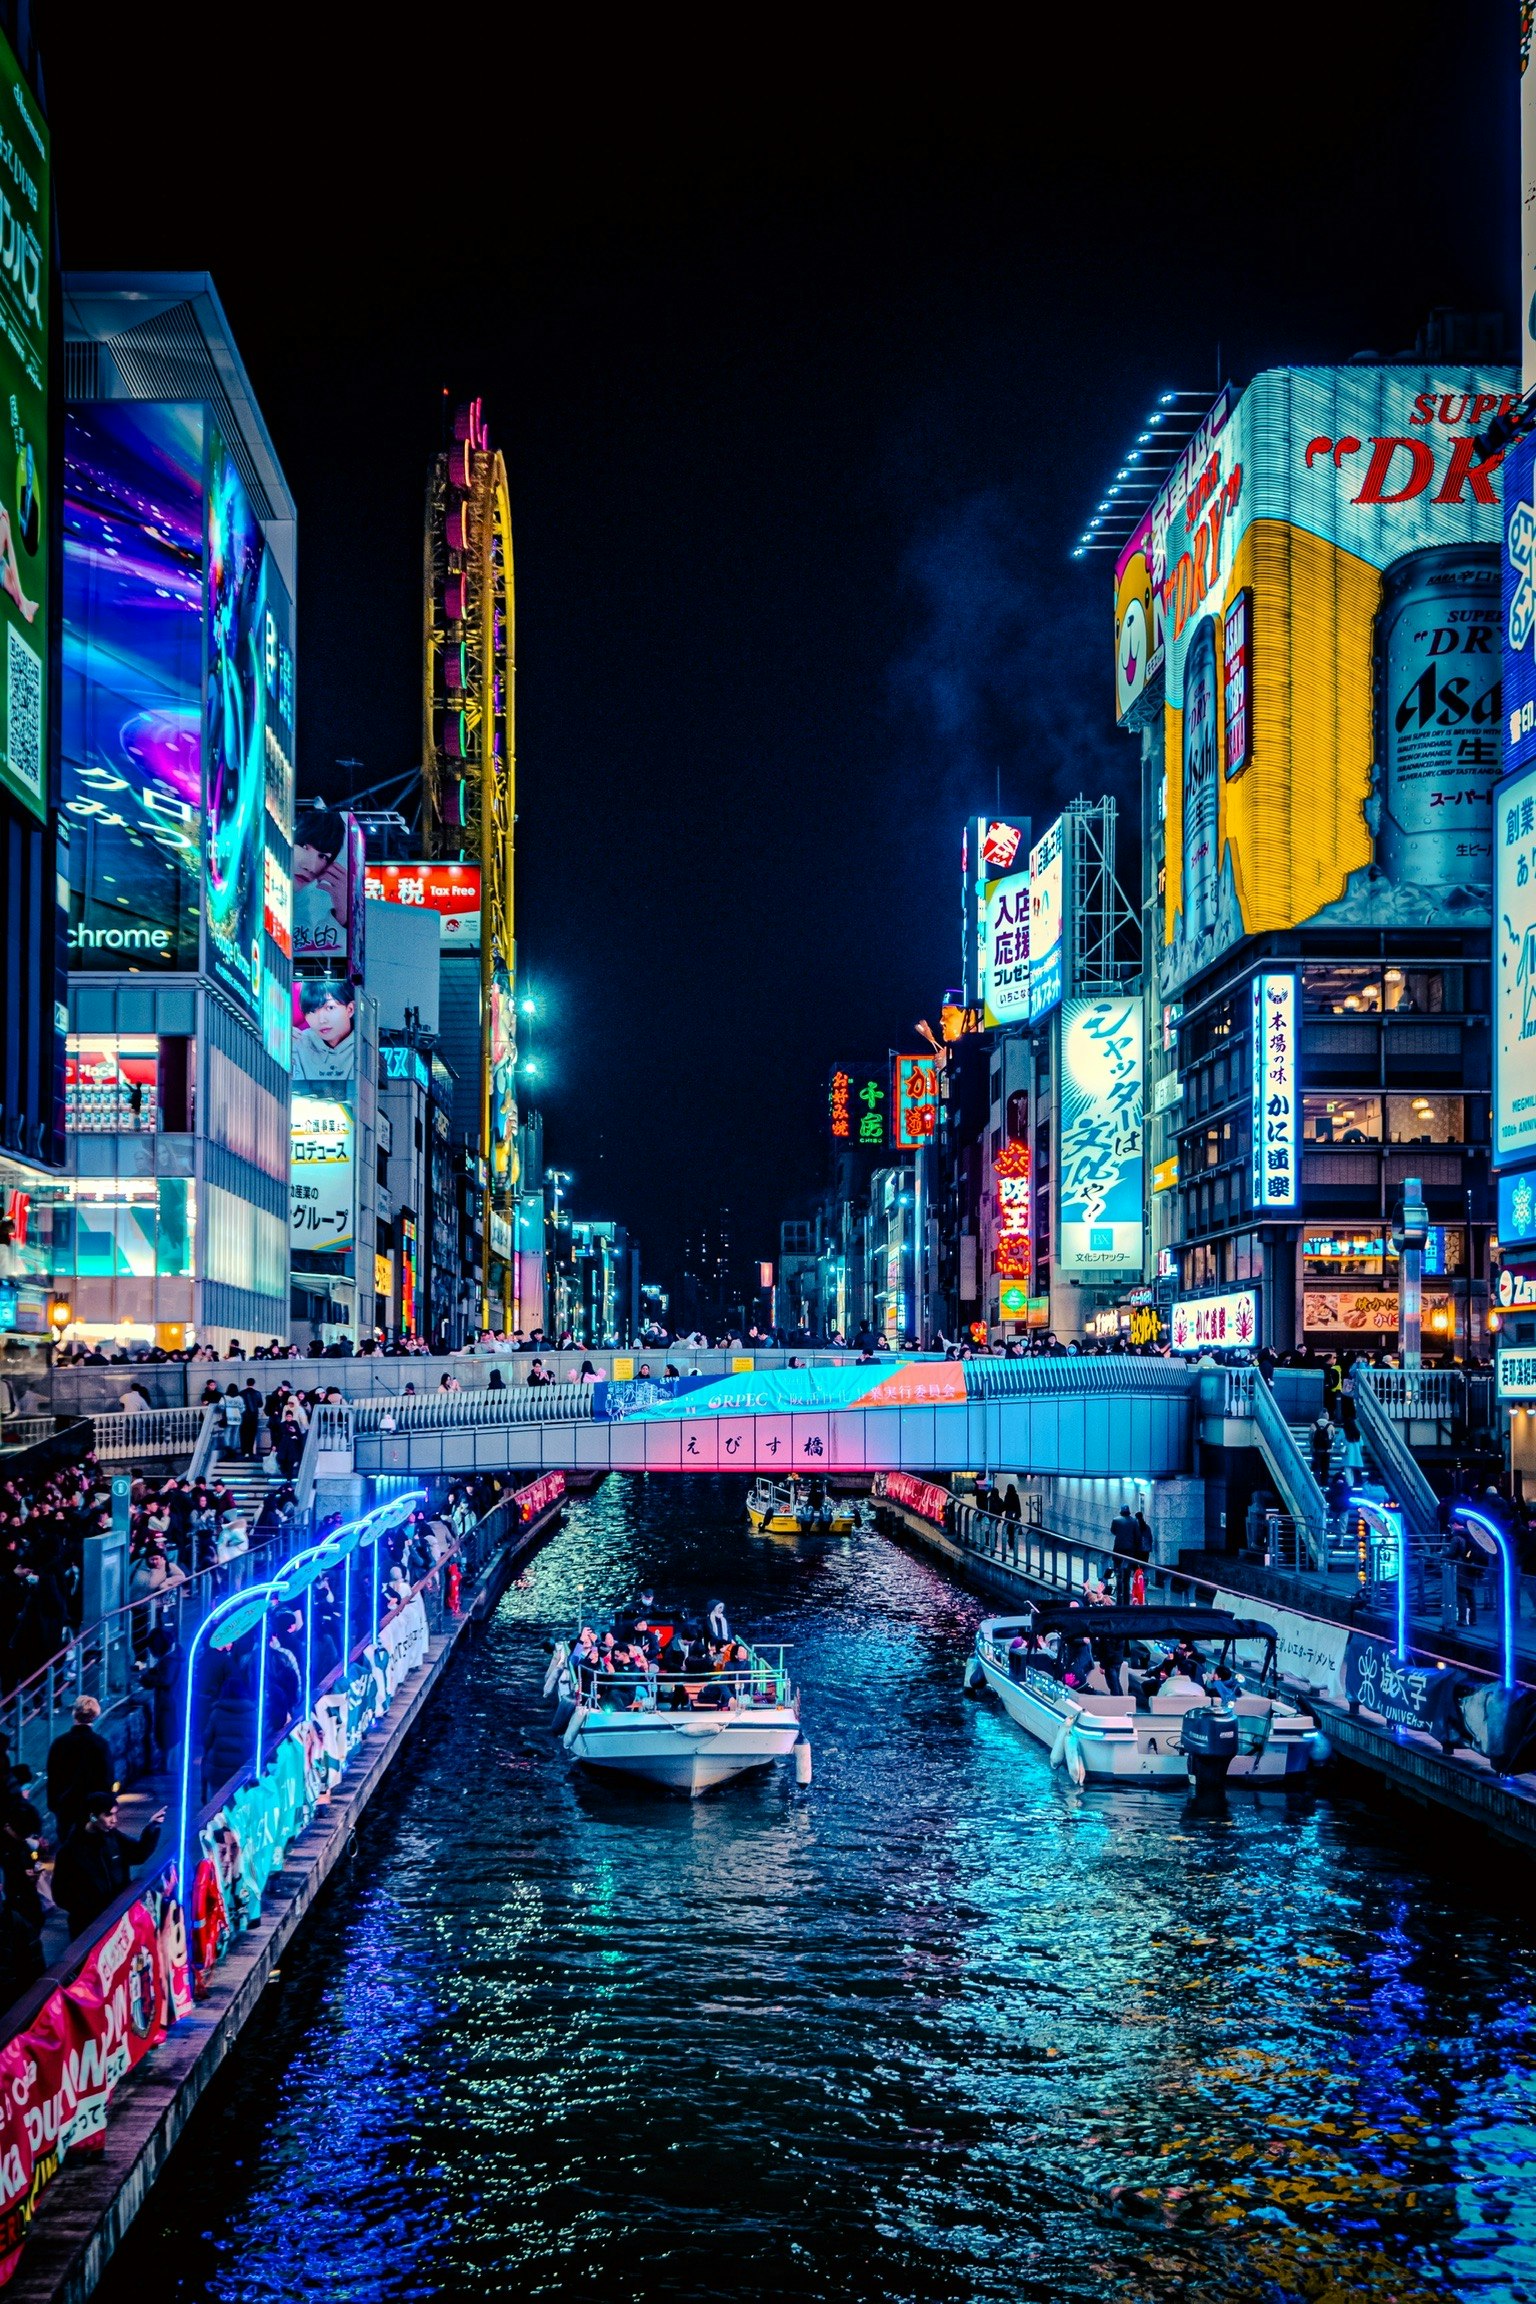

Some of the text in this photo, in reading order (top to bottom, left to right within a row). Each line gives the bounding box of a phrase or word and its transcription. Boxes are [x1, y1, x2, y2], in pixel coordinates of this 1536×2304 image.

[1457, 737, 1498, 765] 生
[430, 885, 450, 896] Tax
[452, 885, 476, 896] Free
[994, 888, 1030, 929] 入店
[67, 922, 170, 948] chrome
[994, 925, 1030, 967] 応援
[1268, 1011, 1288, 1085] 本場の味
[860, 1081, 884, 1137] 千房
[686, 1435, 824, 1457] えびす橋
